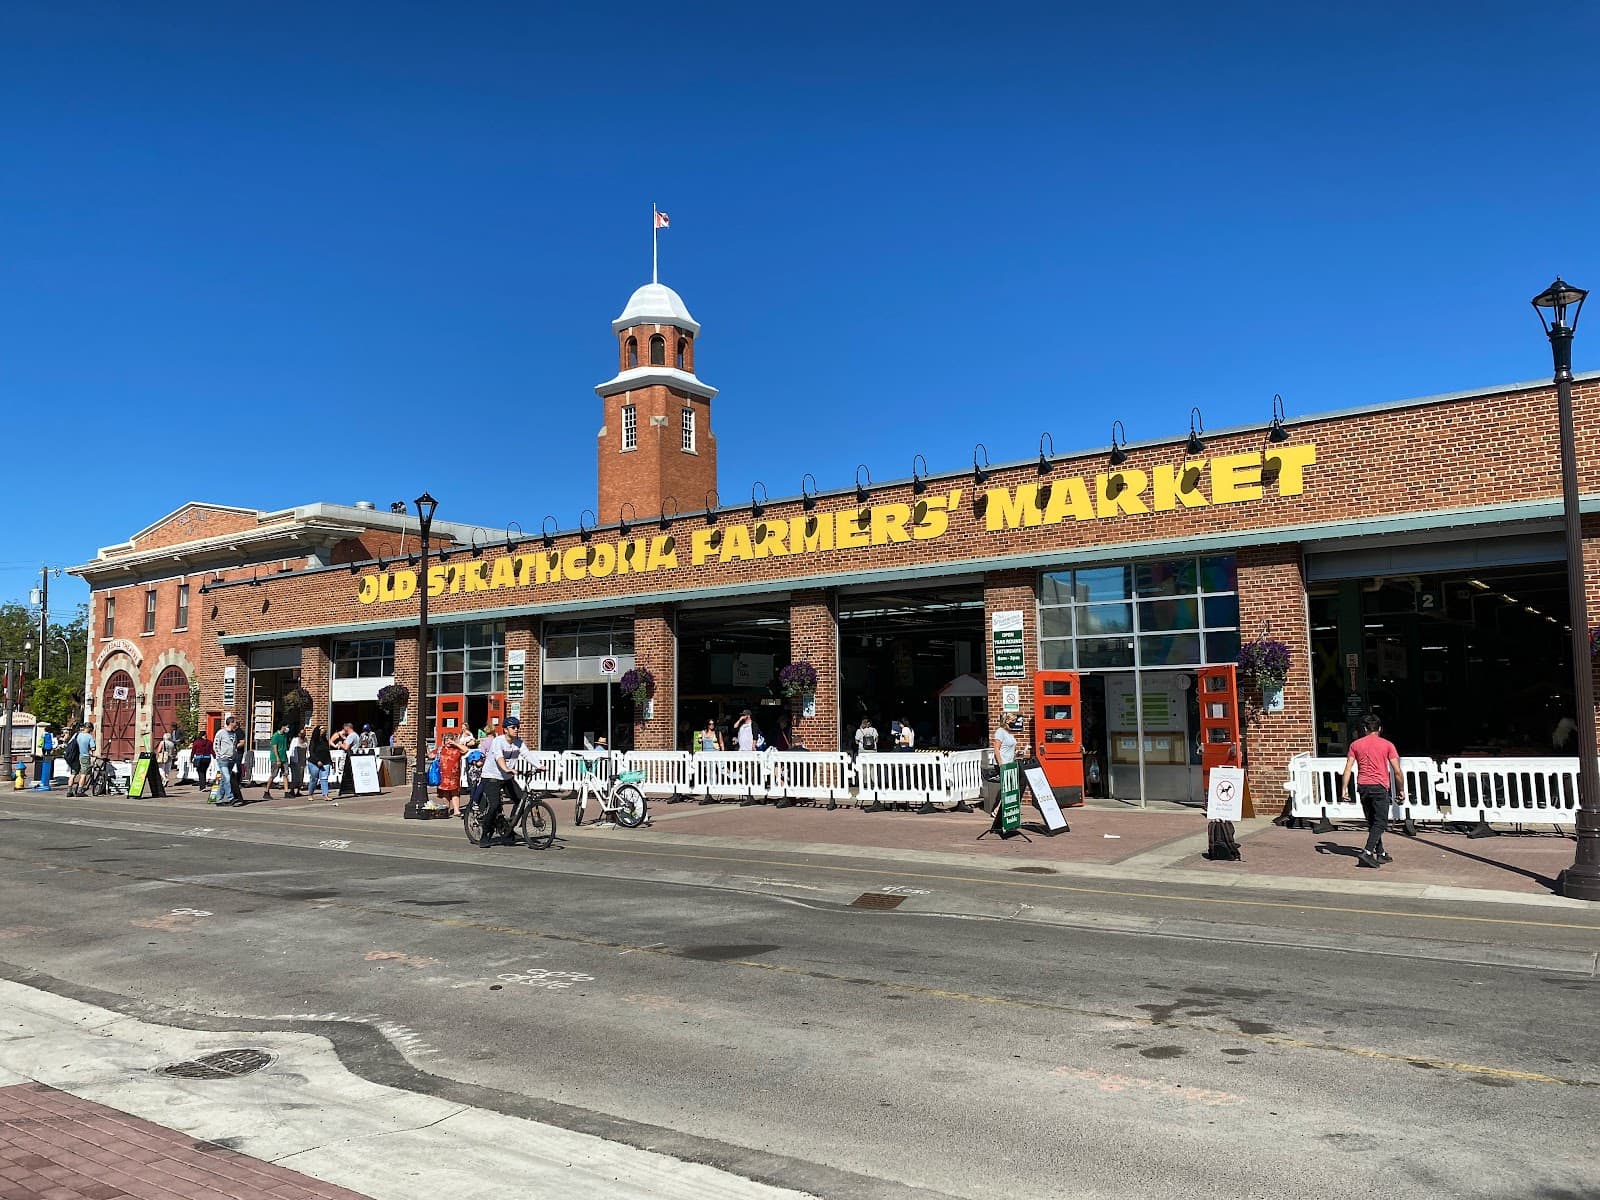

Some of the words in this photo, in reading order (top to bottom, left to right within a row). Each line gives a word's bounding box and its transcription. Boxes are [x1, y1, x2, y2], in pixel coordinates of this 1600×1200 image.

[358, 569, 417, 604] OLD
[427, 535, 678, 597] STRATHCONA
[692, 490, 962, 565] FARMERS'
[985, 444, 1317, 531] MARKET
[1422, 594, 1434, 608] 2
[1002, 768, 1018, 793] ATM
